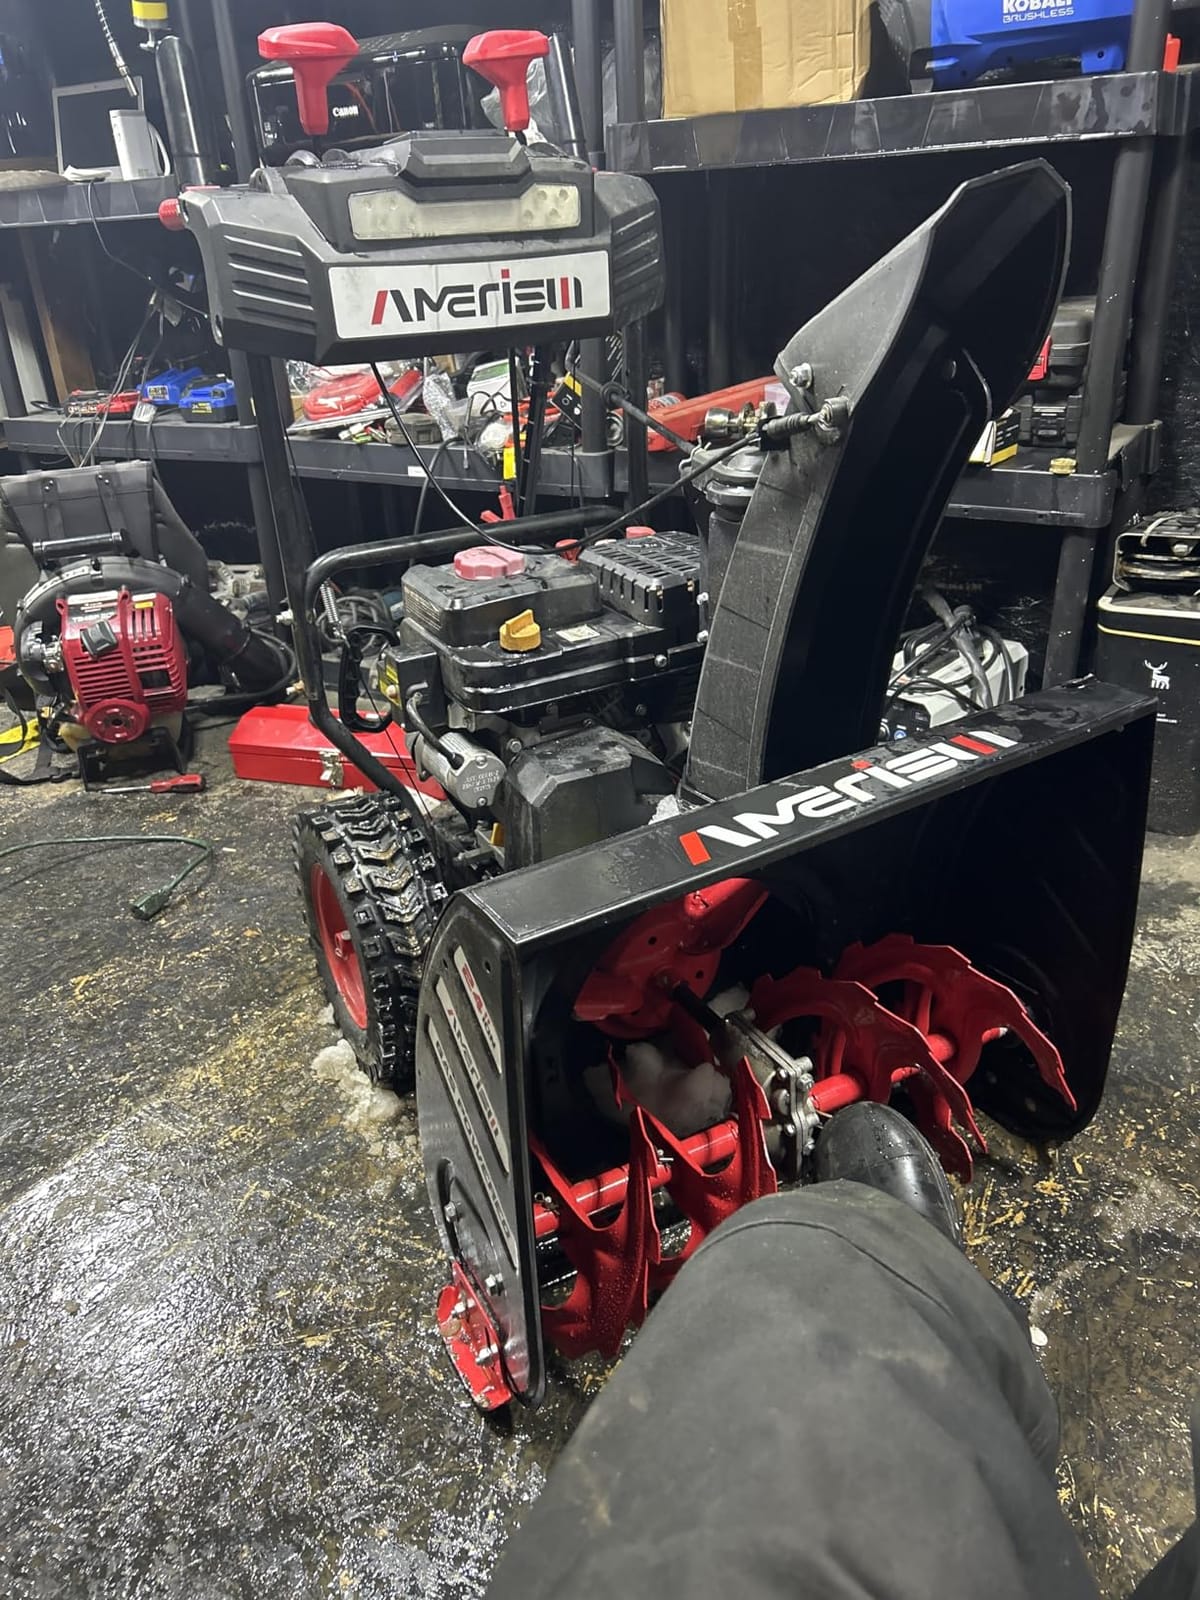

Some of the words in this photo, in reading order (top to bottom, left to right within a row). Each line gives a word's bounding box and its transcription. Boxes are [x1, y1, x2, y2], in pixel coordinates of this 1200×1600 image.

[1002, 7, 1075, 23] BRUSHLESS
[332, 105, 359, 117] Canon
[457, 1097, 510, 1238] POWERED
